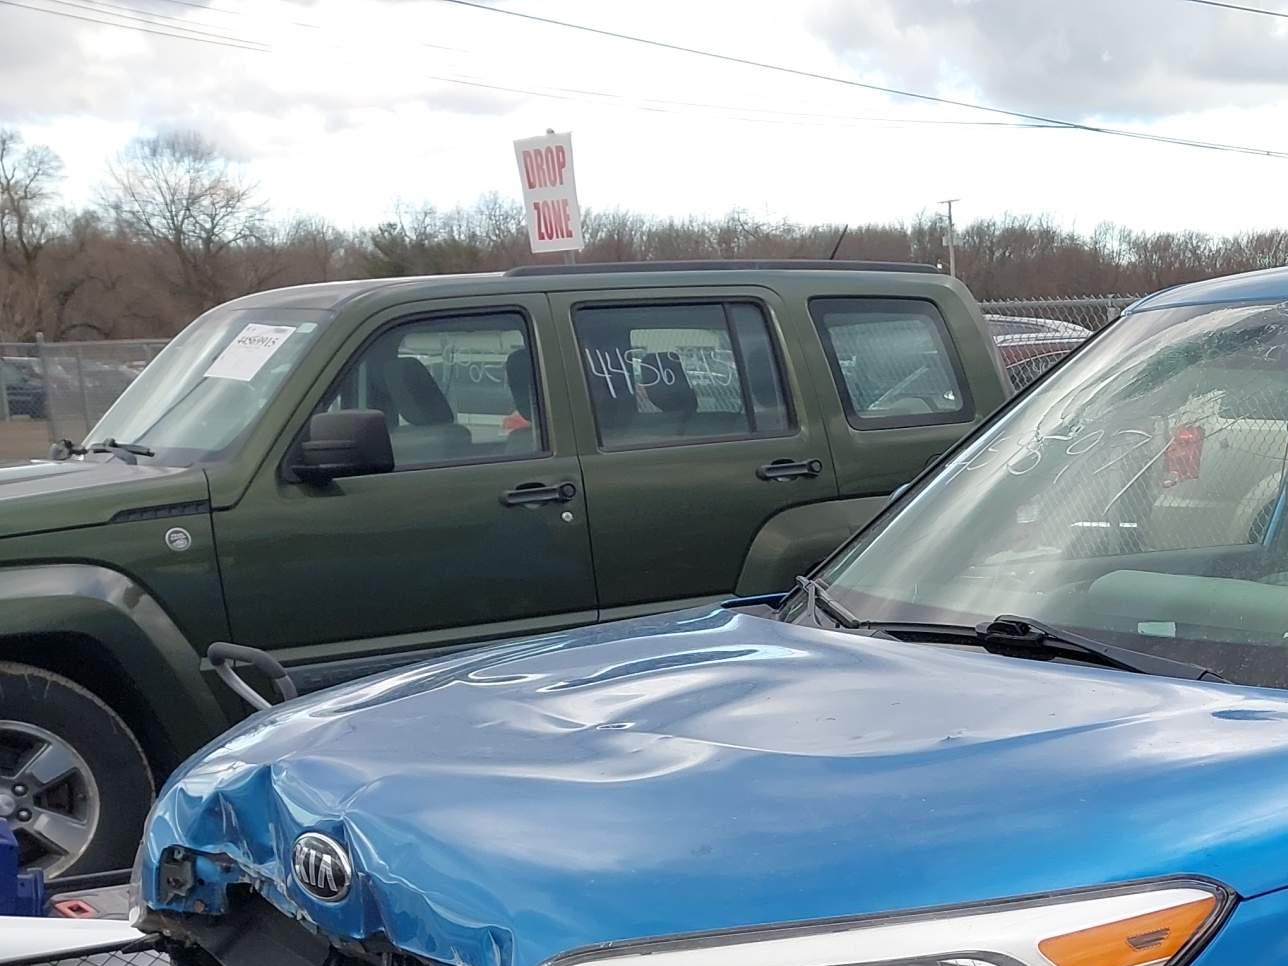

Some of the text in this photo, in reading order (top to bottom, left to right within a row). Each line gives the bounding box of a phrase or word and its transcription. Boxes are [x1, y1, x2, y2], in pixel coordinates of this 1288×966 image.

[522, 145, 566, 189] DROP
[533, 199, 573, 240] ZONE
[295, 843, 338, 892] KIA
